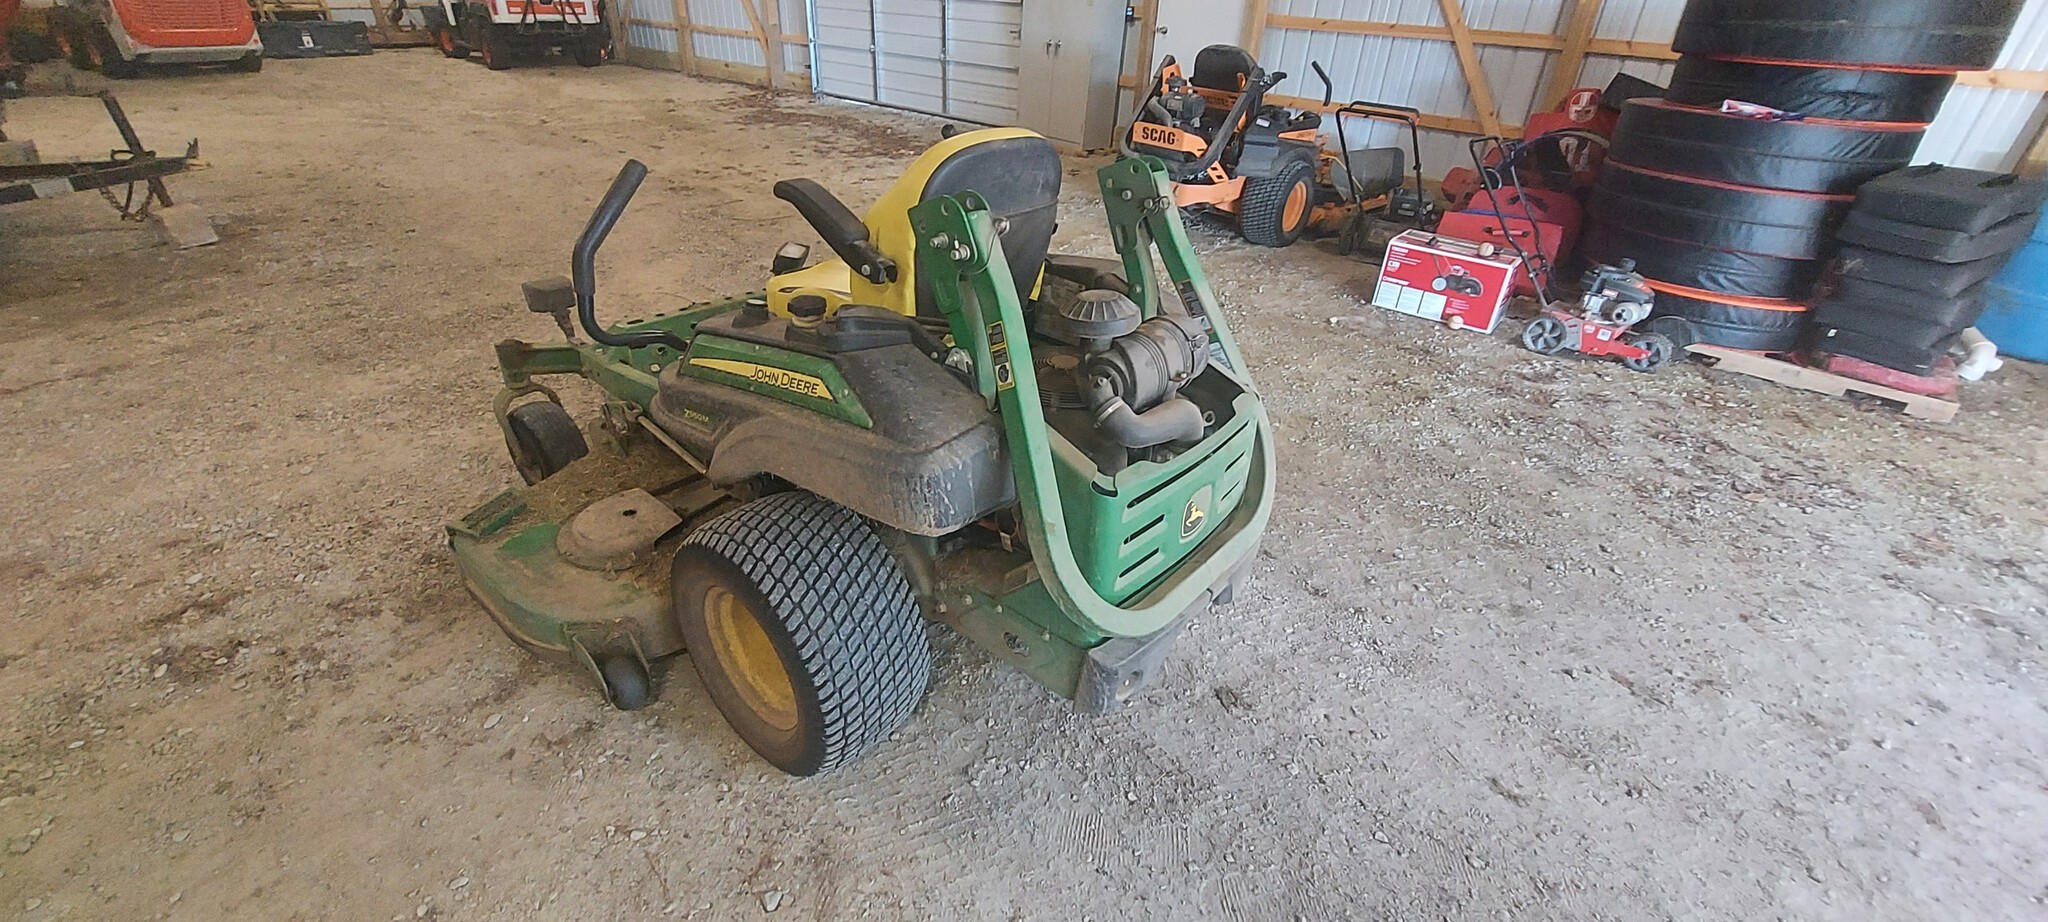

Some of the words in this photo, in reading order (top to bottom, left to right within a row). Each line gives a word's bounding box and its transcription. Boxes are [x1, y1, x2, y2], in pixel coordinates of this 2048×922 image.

[1141, 126, 1176, 145] SCAG
[750, 366, 780, 384] JOHN
[780, 373, 820, 395] DEERE
